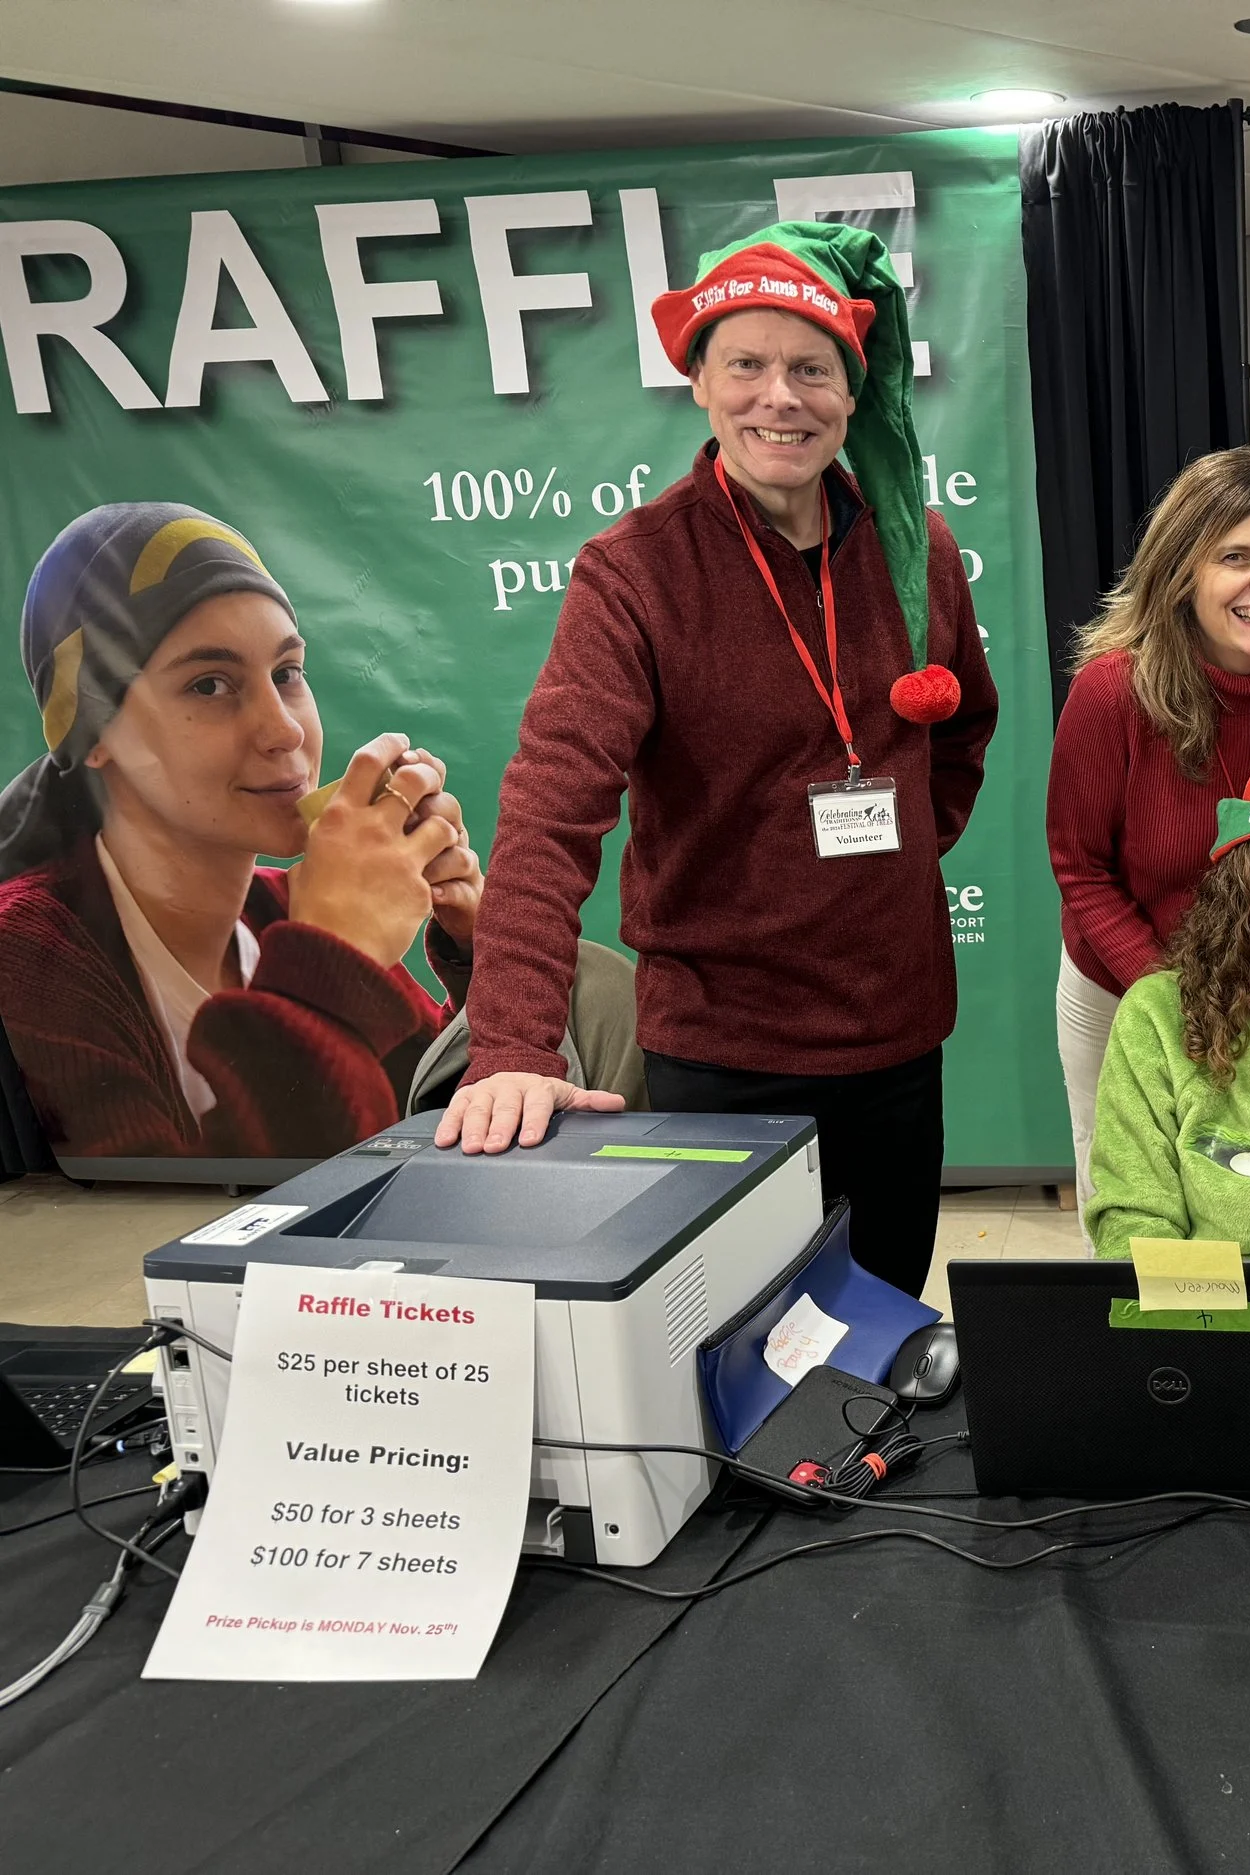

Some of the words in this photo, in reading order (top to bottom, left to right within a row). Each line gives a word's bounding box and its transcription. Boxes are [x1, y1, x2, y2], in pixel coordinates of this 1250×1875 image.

[728, 280, 754, 299] for
[758, 276, 798, 298] Ann's
[801, 283, 838, 316] Place
[423, 467, 572, 521] 100%
[591, 464, 651, 516] of
[819, 808, 863, 823] Celebrating
[840, 822, 866, 830] FESTIVAL
[876, 817, 894, 826] TREES
[836, 834, 883, 844] Volunteer
[297, 1293, 371, 1318] Raffle
[379, 1299, 475, 1325] Tickets
[277, 1351, 316, 1372] $25
[323, 1358, 360, 1378] per
[366, 1357, 429, 1379] sheet
[435, 1362, 458, 1381] of
[463, 1363, 490, 1384] 25
[344, 1383, 420, 1406] tickets
[1152, 1380, 1187, 1391] DELL
[286, 1440, 361, 1464] Value
[369, 1445, 470, 1474] Pricing:
[270, 1501, 314, 1523] $50
[320, 1503, 356, 1525] for
[360, 1506, 375, 1526] 3
[381, 1507, 461, 1530] sheets
[250, 1545, 309, 1568] $100
[314, 1548, 351, 1569] for
[356, 1551, 373, 1570] 7
[376, 1552, 458, 1575] sheets
[205, 1614, 243, 1629] Prize
[246, 1616, 297, 1633] Pickup
[300, 1619, 314, 1631] is
[317, 1619, 387, 1633] MONDAY
[388, 1623, 421, 1635] Nov.
